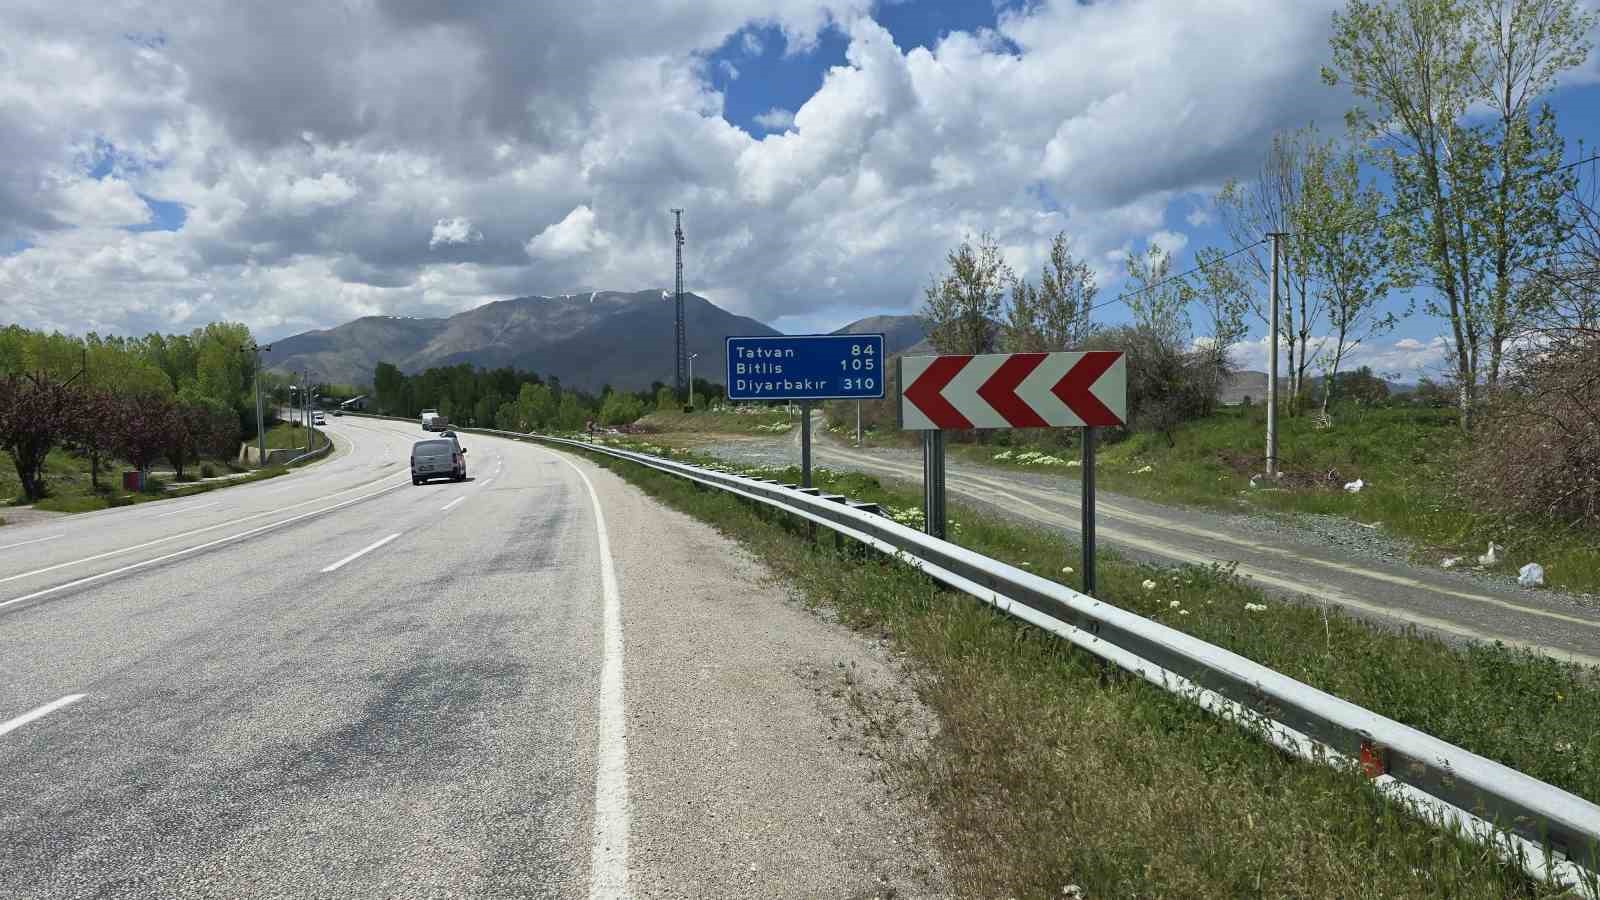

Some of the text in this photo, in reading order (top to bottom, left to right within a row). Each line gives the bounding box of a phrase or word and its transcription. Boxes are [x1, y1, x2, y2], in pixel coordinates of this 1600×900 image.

[736, 344, 874, 358] Tatvan 84
[736, 359, 874, 374] Bitlis 105
[736, 378, 874, 394] Diyarbakır 310
